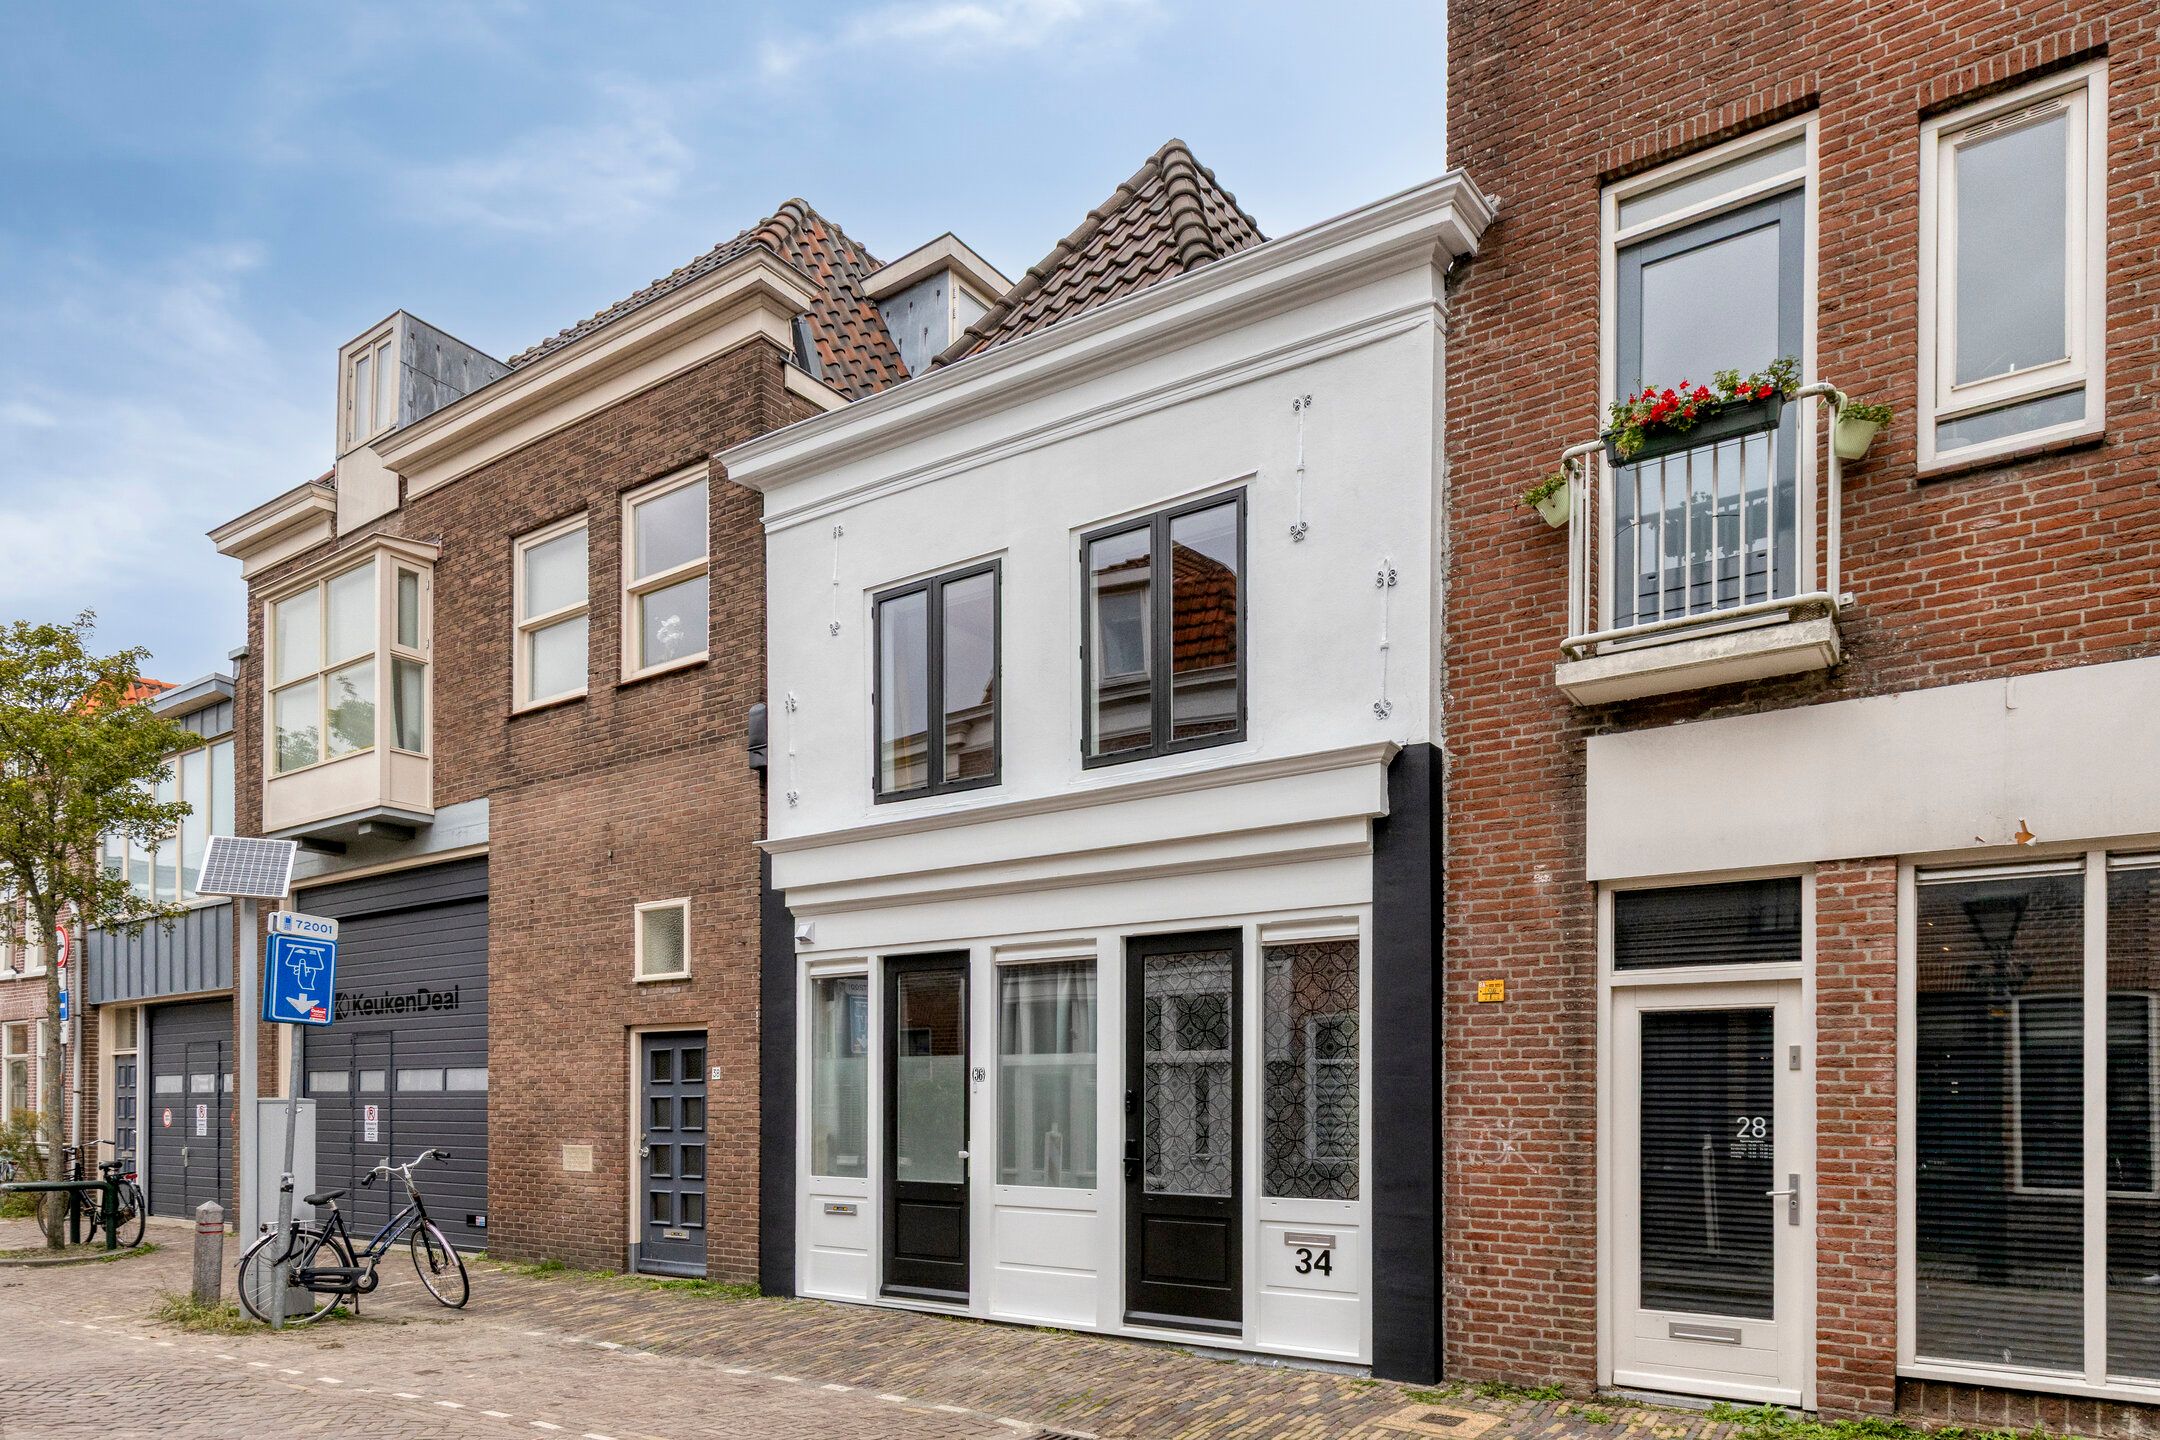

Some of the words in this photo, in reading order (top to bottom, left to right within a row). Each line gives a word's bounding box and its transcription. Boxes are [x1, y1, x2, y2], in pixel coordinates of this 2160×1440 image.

[295, 919, 332, 934] 72001
[352, 985, 459, 1016] KeukenDeal
[974, 1067, 985, 1081] 36
[1737, 1116, 1766, 1138] 28
[1295, 1248, 1333, 1276] 34
